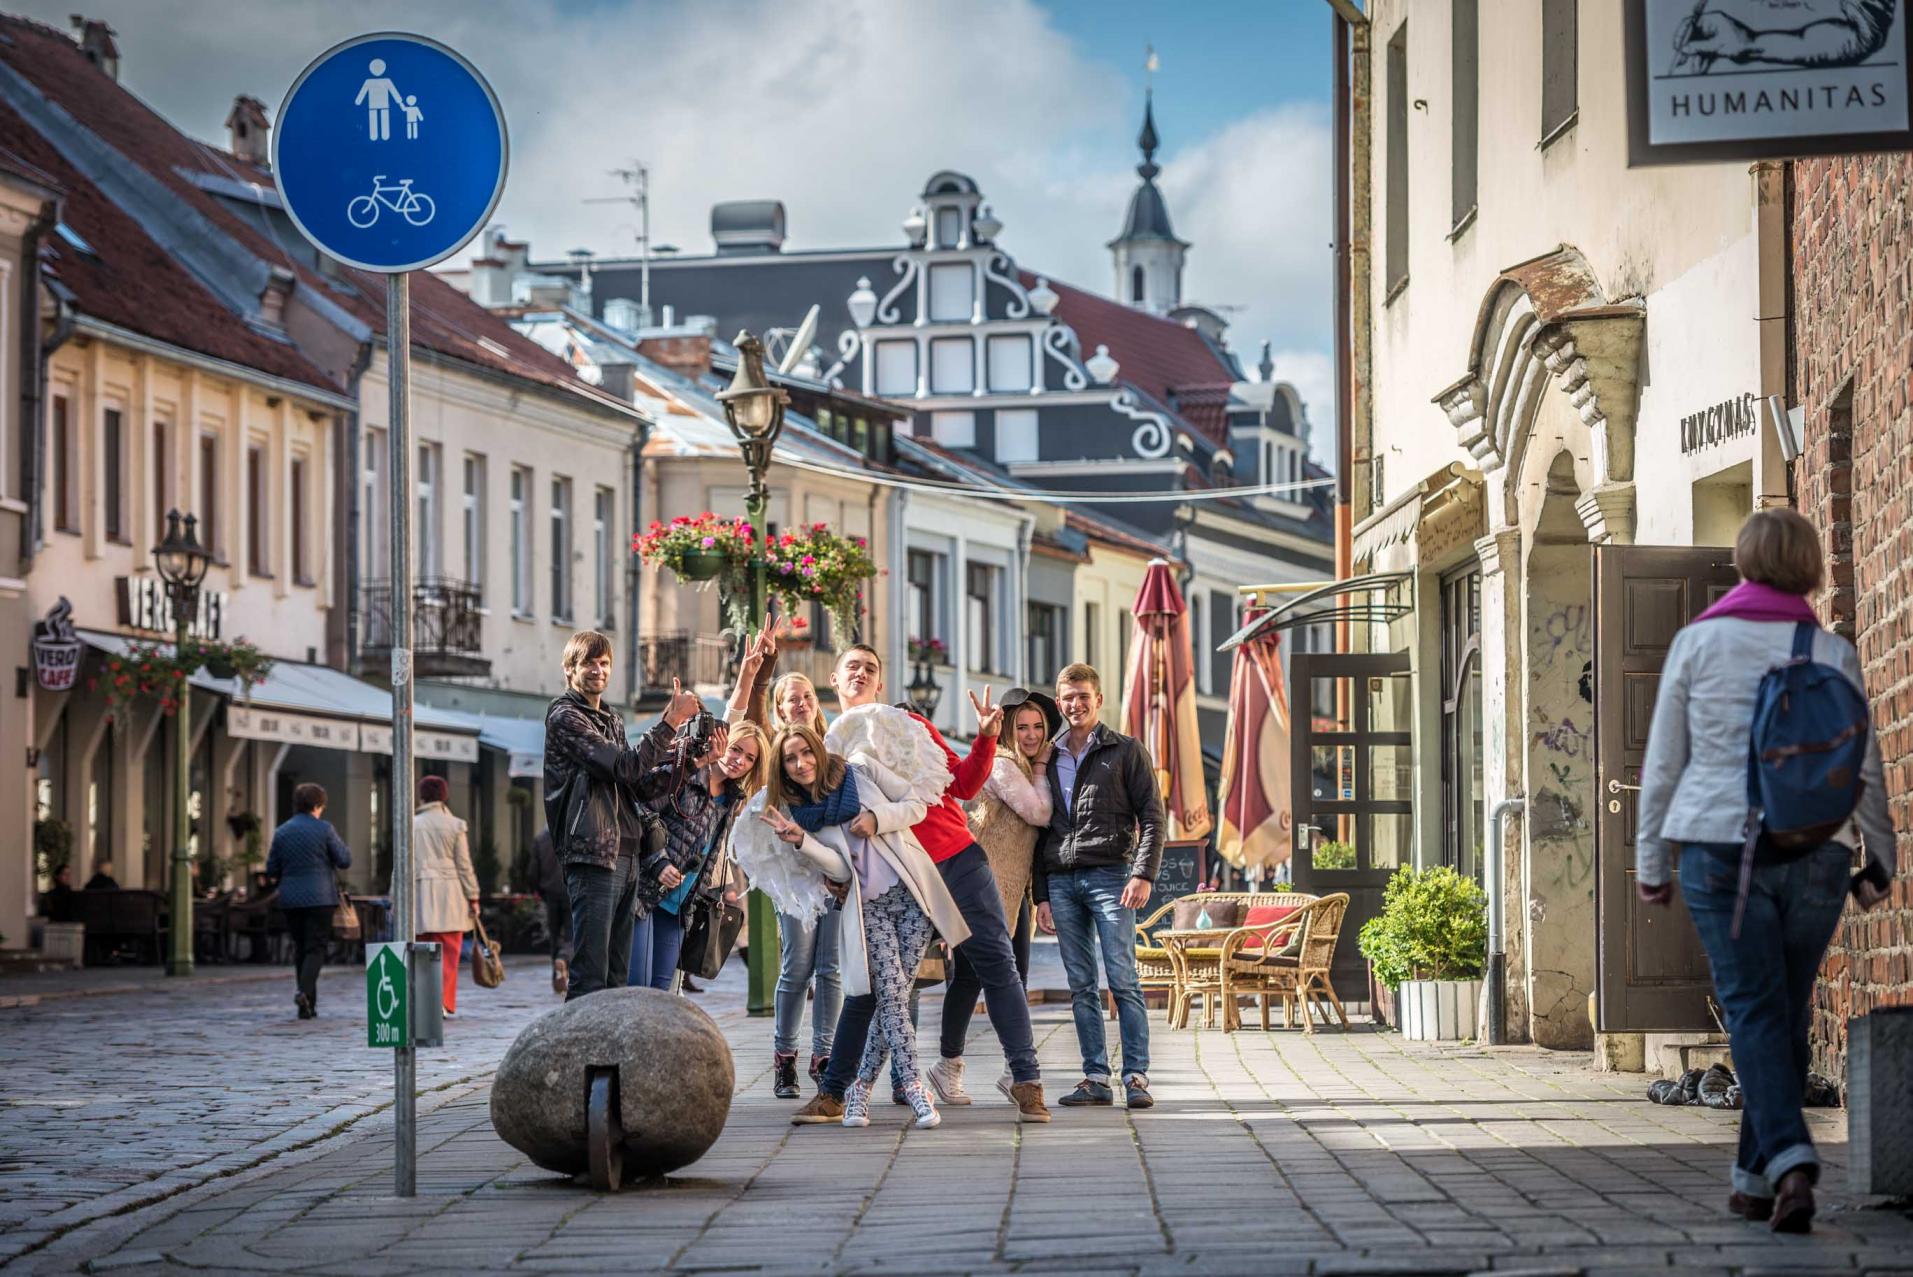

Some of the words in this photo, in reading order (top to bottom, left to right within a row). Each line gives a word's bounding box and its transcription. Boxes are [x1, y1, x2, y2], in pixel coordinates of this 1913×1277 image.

[1671, 82, 1886, 117] HUMANITAS
[36, 646, 78, 668] VERO
[375, 1022, 390, 1043] 300
[391, 1027, 399, 1042] m
